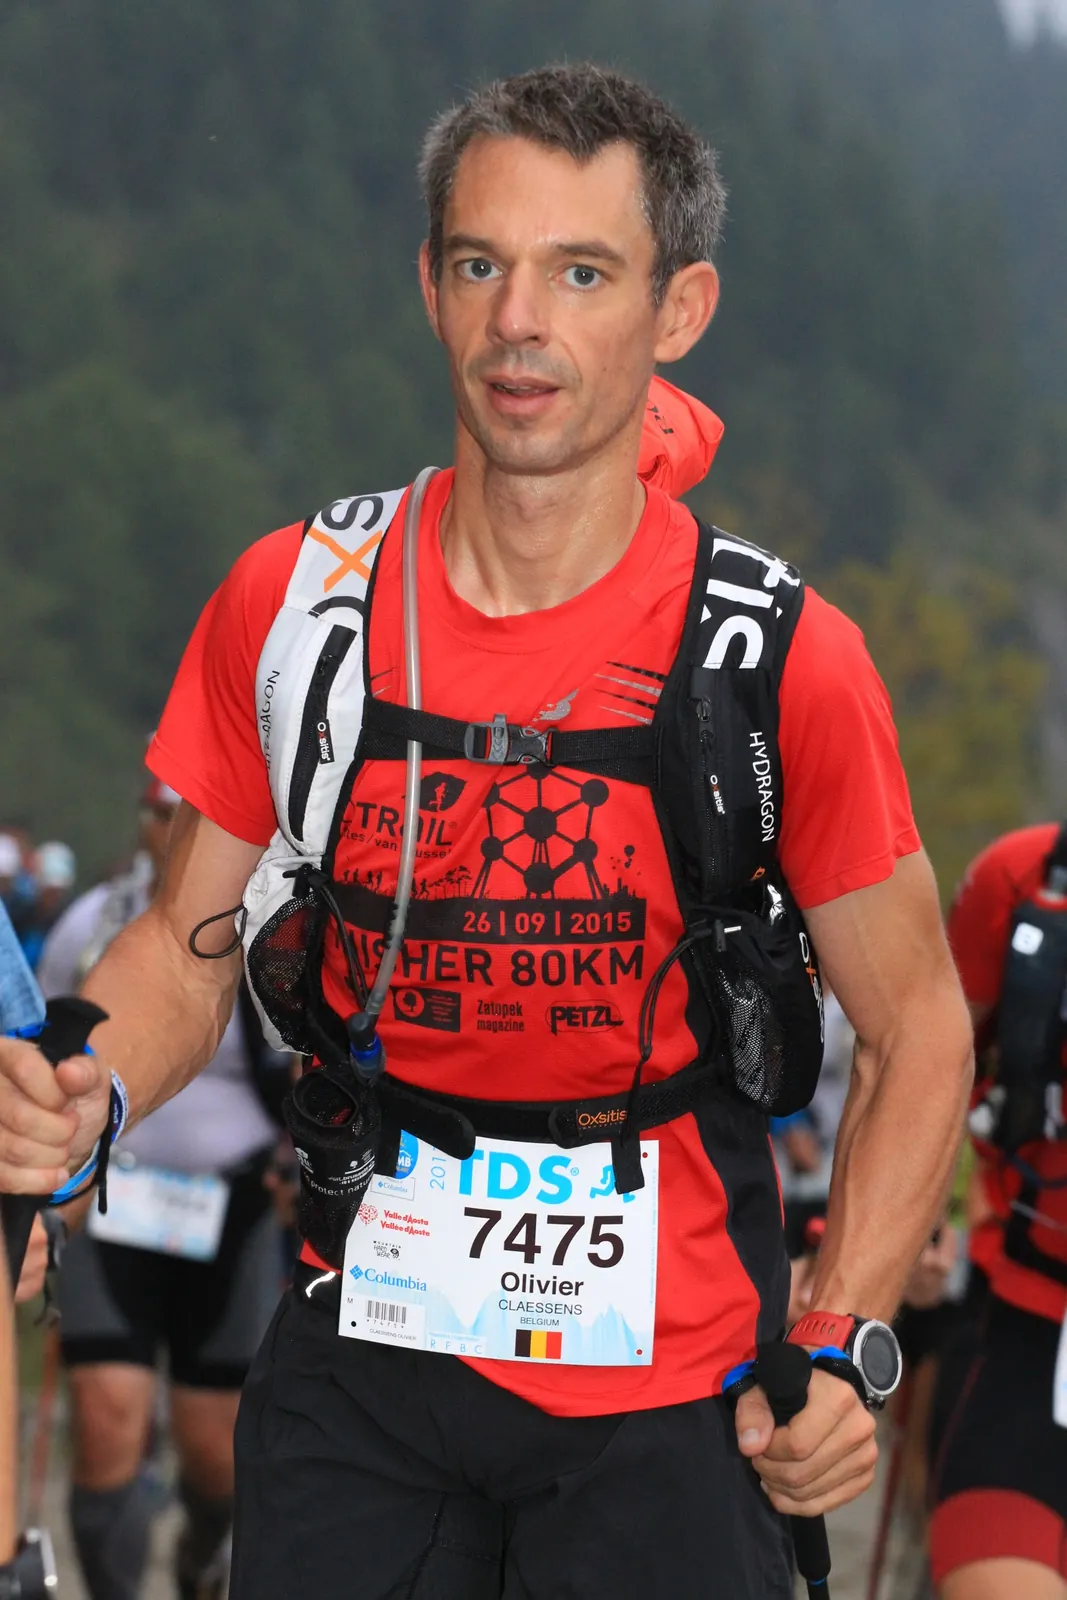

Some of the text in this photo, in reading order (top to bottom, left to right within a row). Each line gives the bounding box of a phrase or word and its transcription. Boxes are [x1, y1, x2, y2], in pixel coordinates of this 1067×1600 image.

[749, 731, 775, 842] HYDRAGON
[375, 838, 398, 852] van
[463, 911, 491, 933] 26
[514, 912, 545, 935] 09
[570, 911, 631, 934] 2015
[511, 944, 643, 987] 80KM
[477, 1019, 525, 1032] magazine
[549, 1006, 624, 1035] PETZL
[578, 1108, 627, 1126] Oxsitis
[383, 1210, 402, 1220] Valle
[464, 1206, 625, 1268] 7475
[364, 1268, 427, 1292] Columbia
[500, 1272, 584, 1296] Olivier
[498, 1299, 583, 1316] CLAESSENS
[519, 1316, 560, 1327] BELGIUM
[430, 1339, 483, 1354] R F B C
